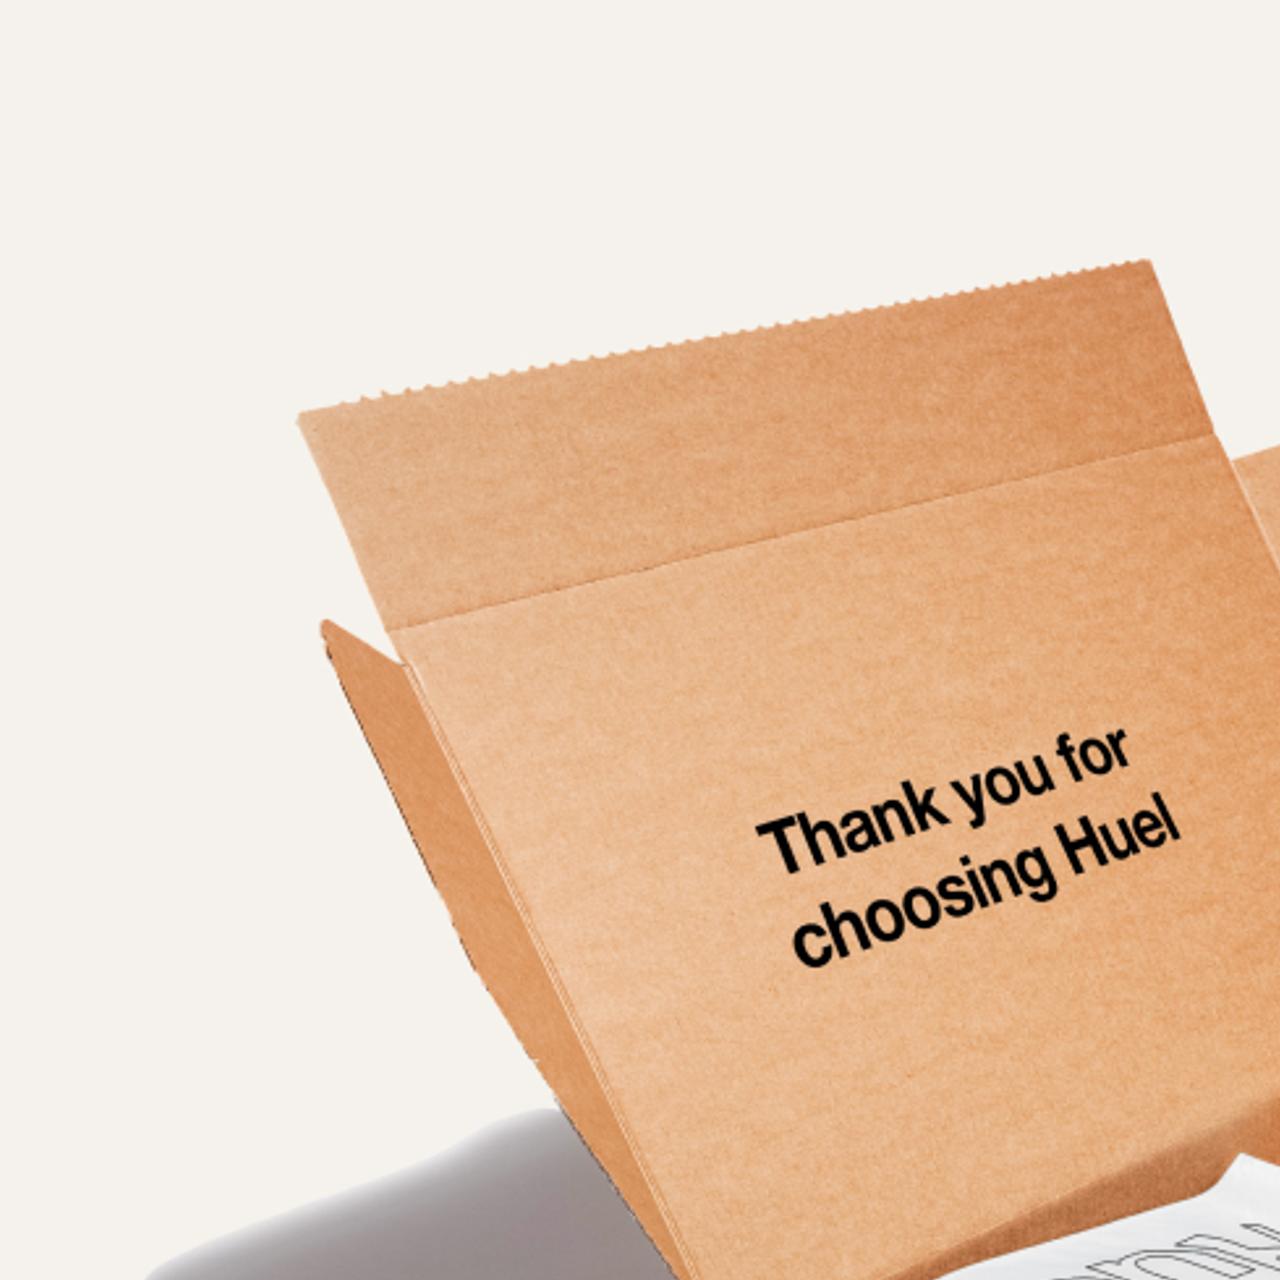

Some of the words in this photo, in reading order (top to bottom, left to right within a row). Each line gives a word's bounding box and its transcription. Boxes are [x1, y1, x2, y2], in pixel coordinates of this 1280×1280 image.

[755, 780, 950, 874] Thank
[950, 754, 1055, 829] you
[1056, 729, 1128, 782] for
[793, 846, 1058, 968] choosing
[1053, 791, 1181, 875] Huel
